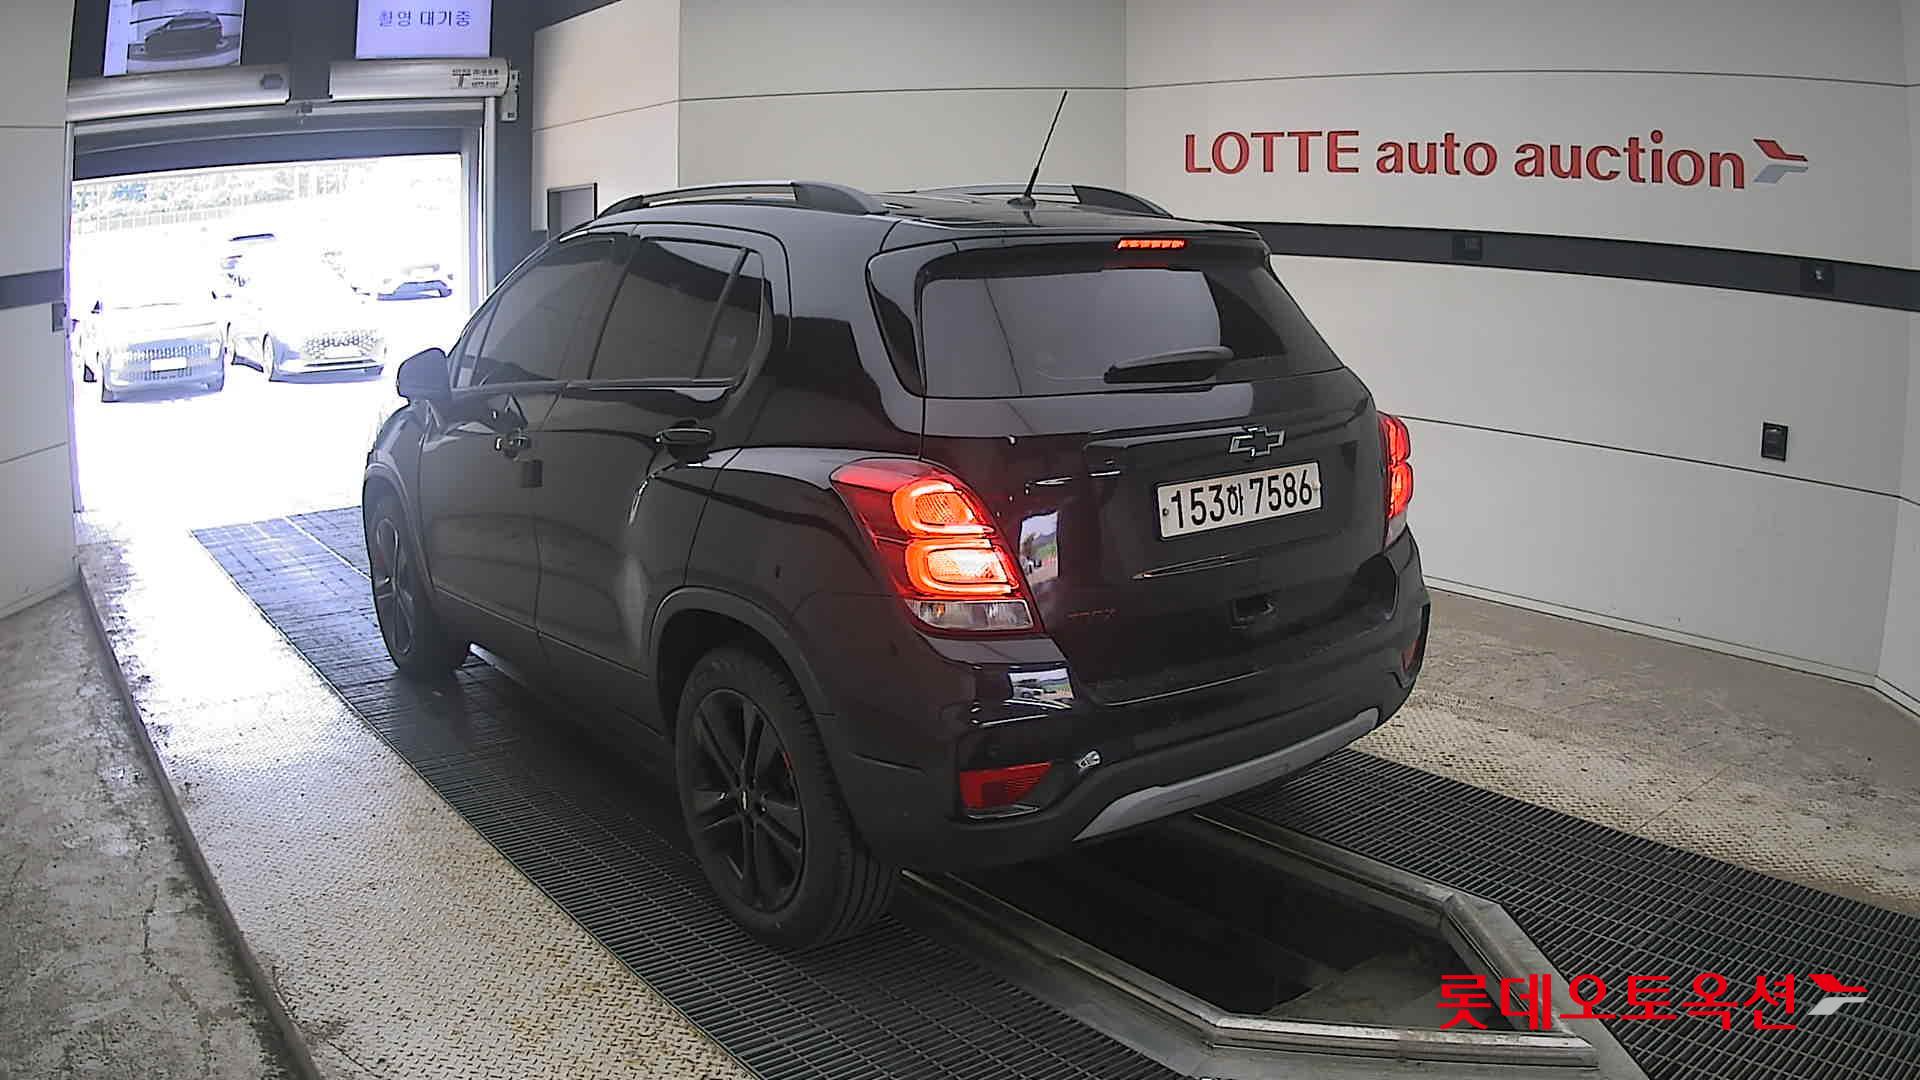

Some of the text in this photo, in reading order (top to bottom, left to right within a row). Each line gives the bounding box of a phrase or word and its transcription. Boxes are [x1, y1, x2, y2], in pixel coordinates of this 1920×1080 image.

[420, 10, 472, 27] 대기중
[1185, 131, 1744, 188] LOTTE auto auction
[1249, 470, 1313, 513] 7586
